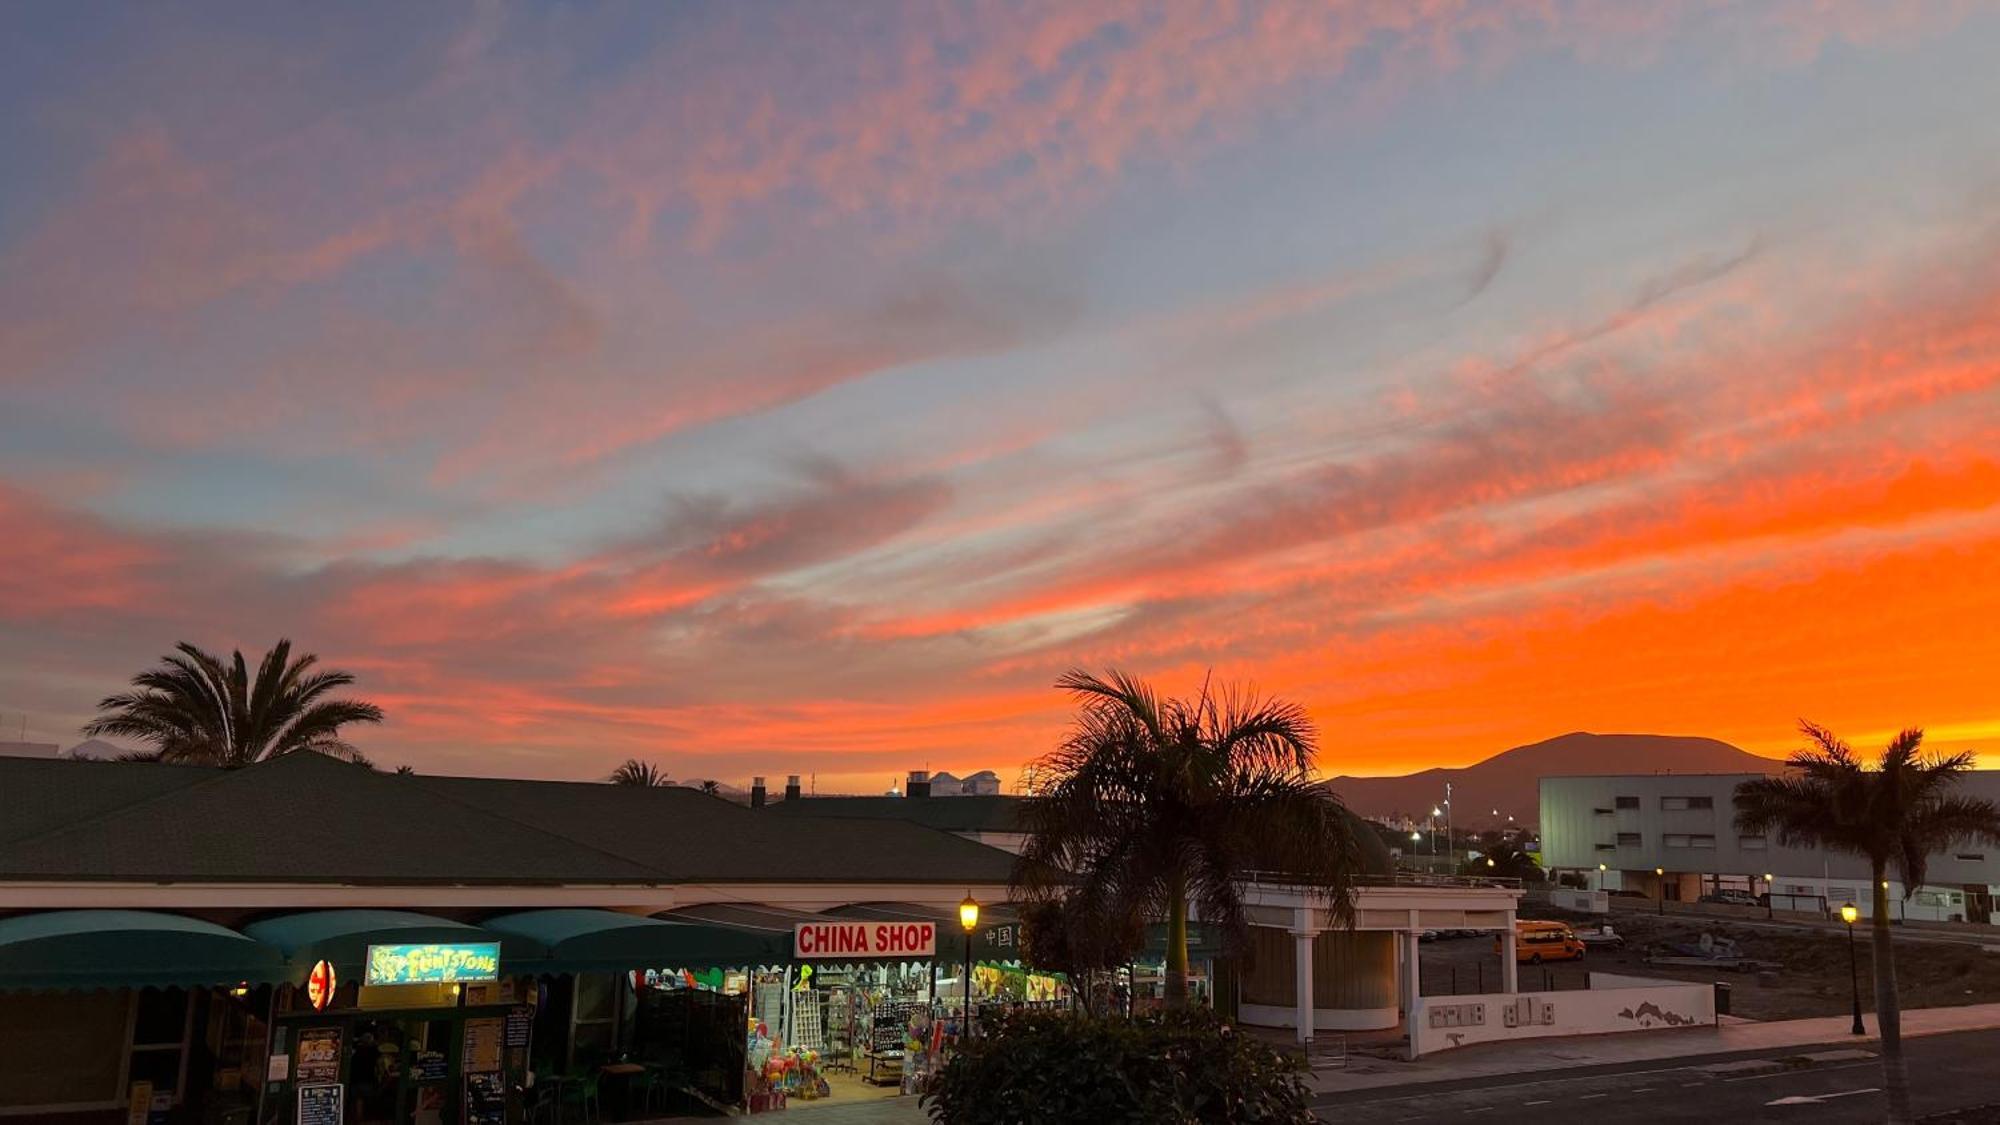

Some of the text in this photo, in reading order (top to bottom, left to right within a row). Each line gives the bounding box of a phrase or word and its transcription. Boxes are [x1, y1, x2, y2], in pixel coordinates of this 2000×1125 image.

[799, 924, 932, 953] CHINA SHOP
[985, 925, 1022, 947] 中国
